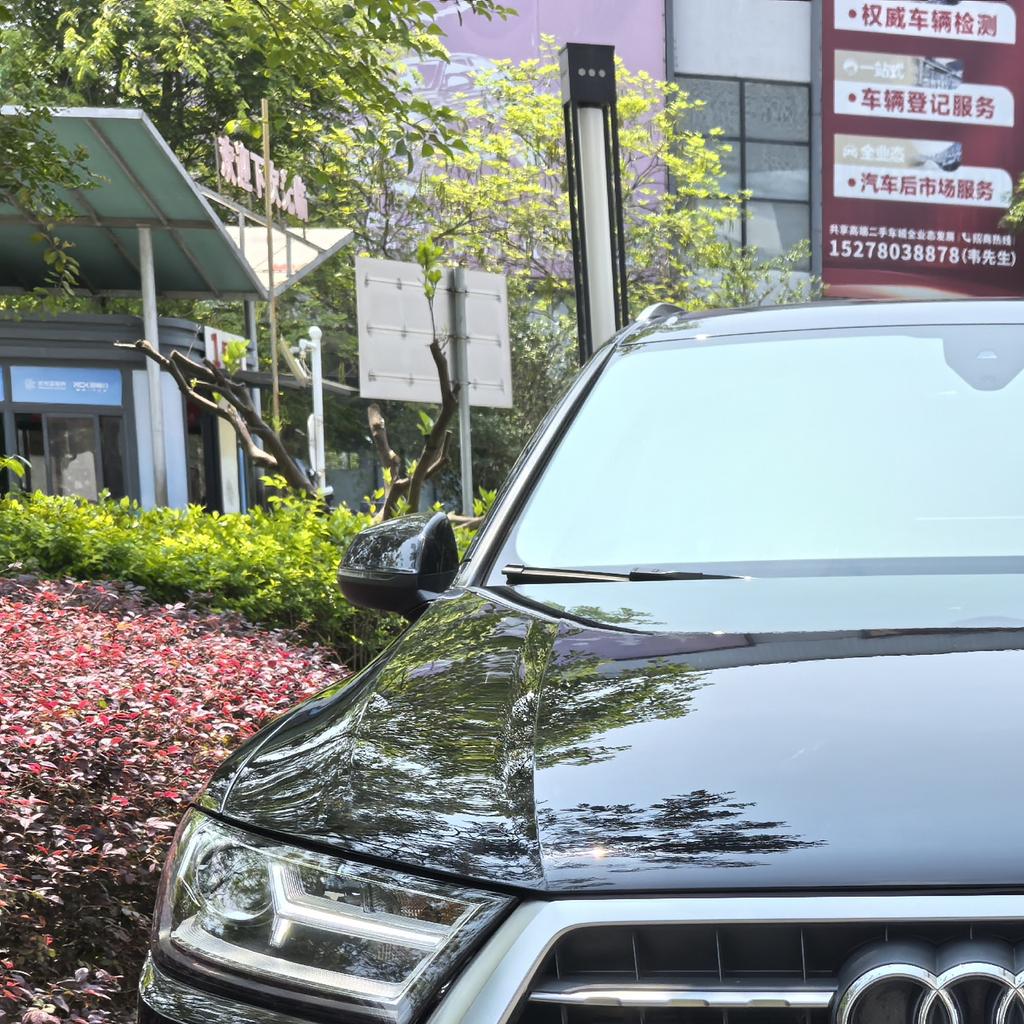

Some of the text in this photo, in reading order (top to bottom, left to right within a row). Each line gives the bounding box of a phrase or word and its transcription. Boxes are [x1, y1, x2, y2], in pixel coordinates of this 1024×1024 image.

[862, 3, 998, 37] 权威车辆检测
[861, 87, 996, 120] 车辆登记服务
[860, 172, 995, 201] 汽车后市场服务
